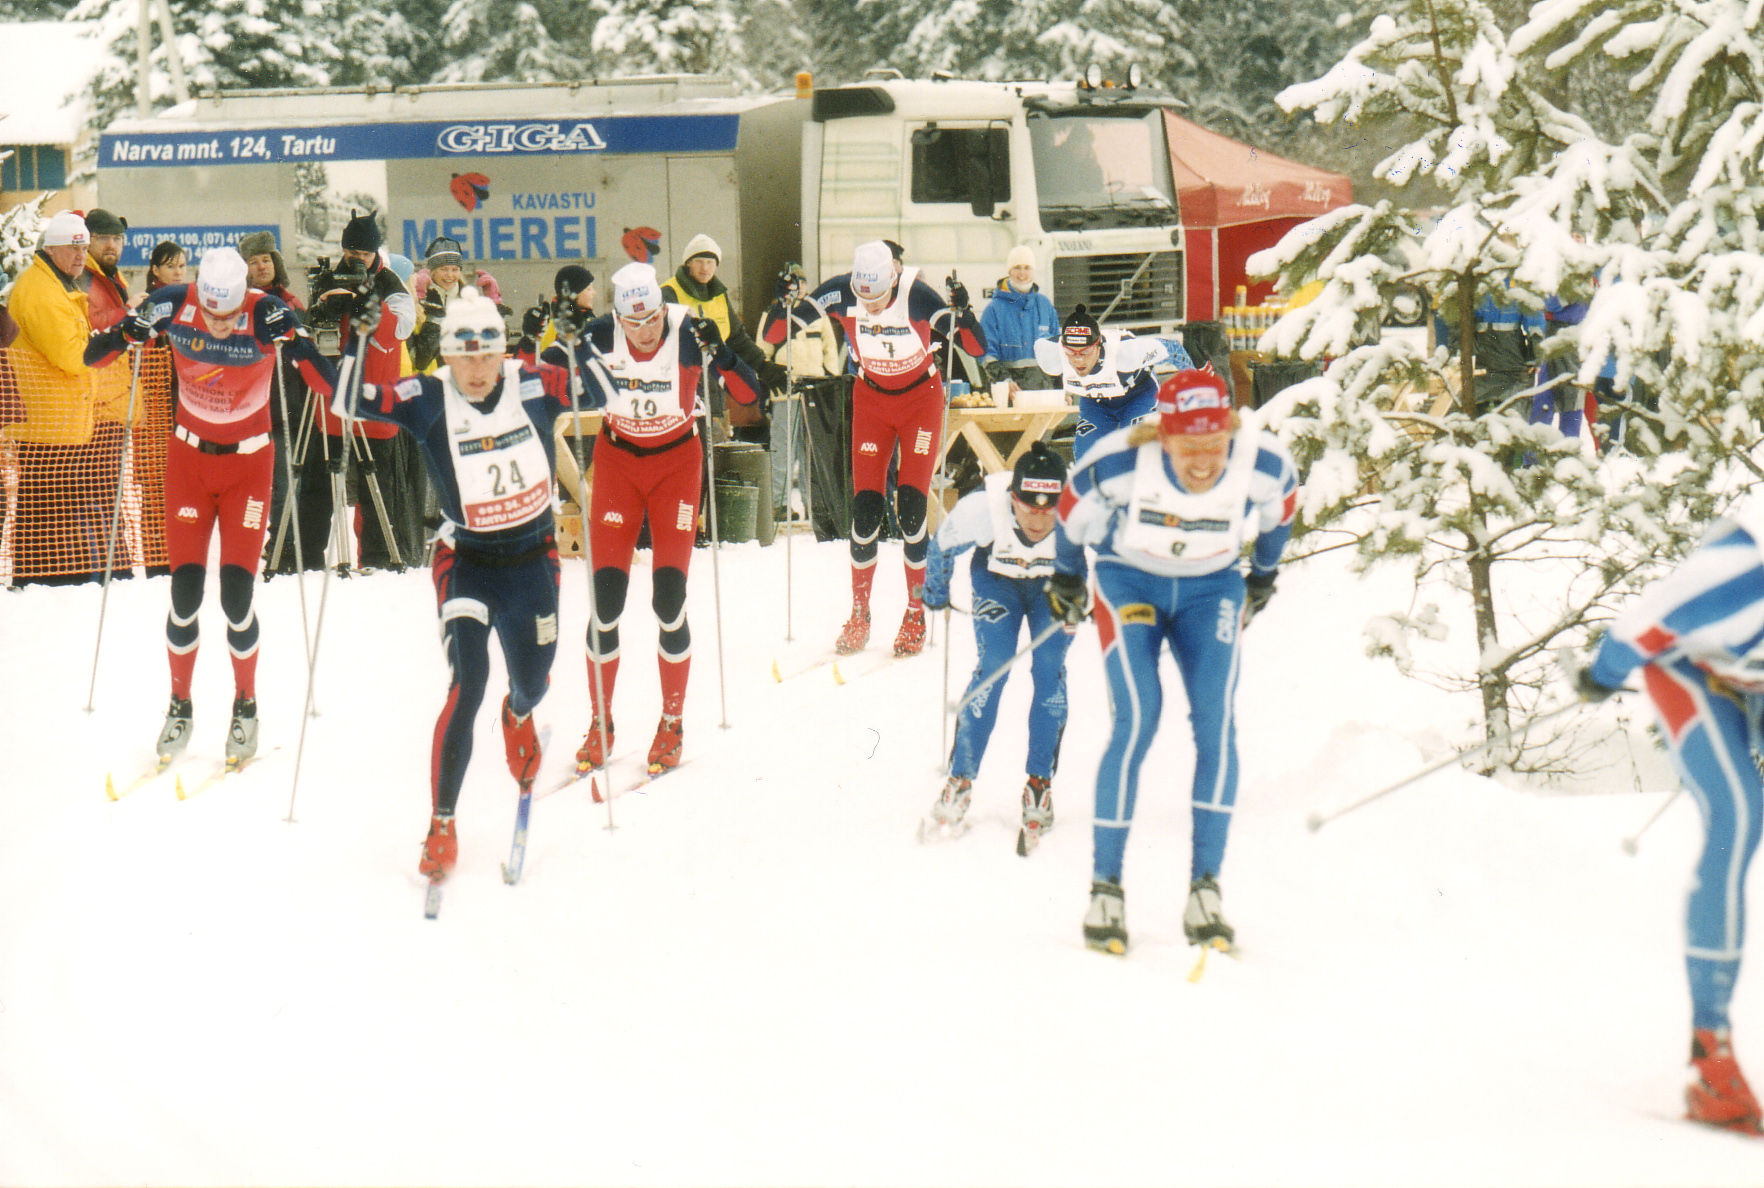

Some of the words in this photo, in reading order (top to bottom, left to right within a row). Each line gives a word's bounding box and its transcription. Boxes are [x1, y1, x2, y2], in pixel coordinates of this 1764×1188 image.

[113, 140, 174, 161] Narva
[177, 140, 223, 159] mnt.
[230, 136, 271, 159] 124,
[281, 135, 336, 156] Tartu
[438, 124, 607, 152] GIGA
[512, 193, 595, 209] KAVASTU
[403, 216, 596, 260] MEIEREI
[882, 341, 896, 358] 7
[631, 398, 658, 419] 19
[861, 442, 878, 453] AXA
[914, 428, 932, 455] SWIX
[488, 460, 526, 496] 24
[178, 507, 198, 518] AXA
[242, 497, 264, 530] SWIX
[604, 512, 623, 524] AXA
[676, 501, 694, 531] SWIX
